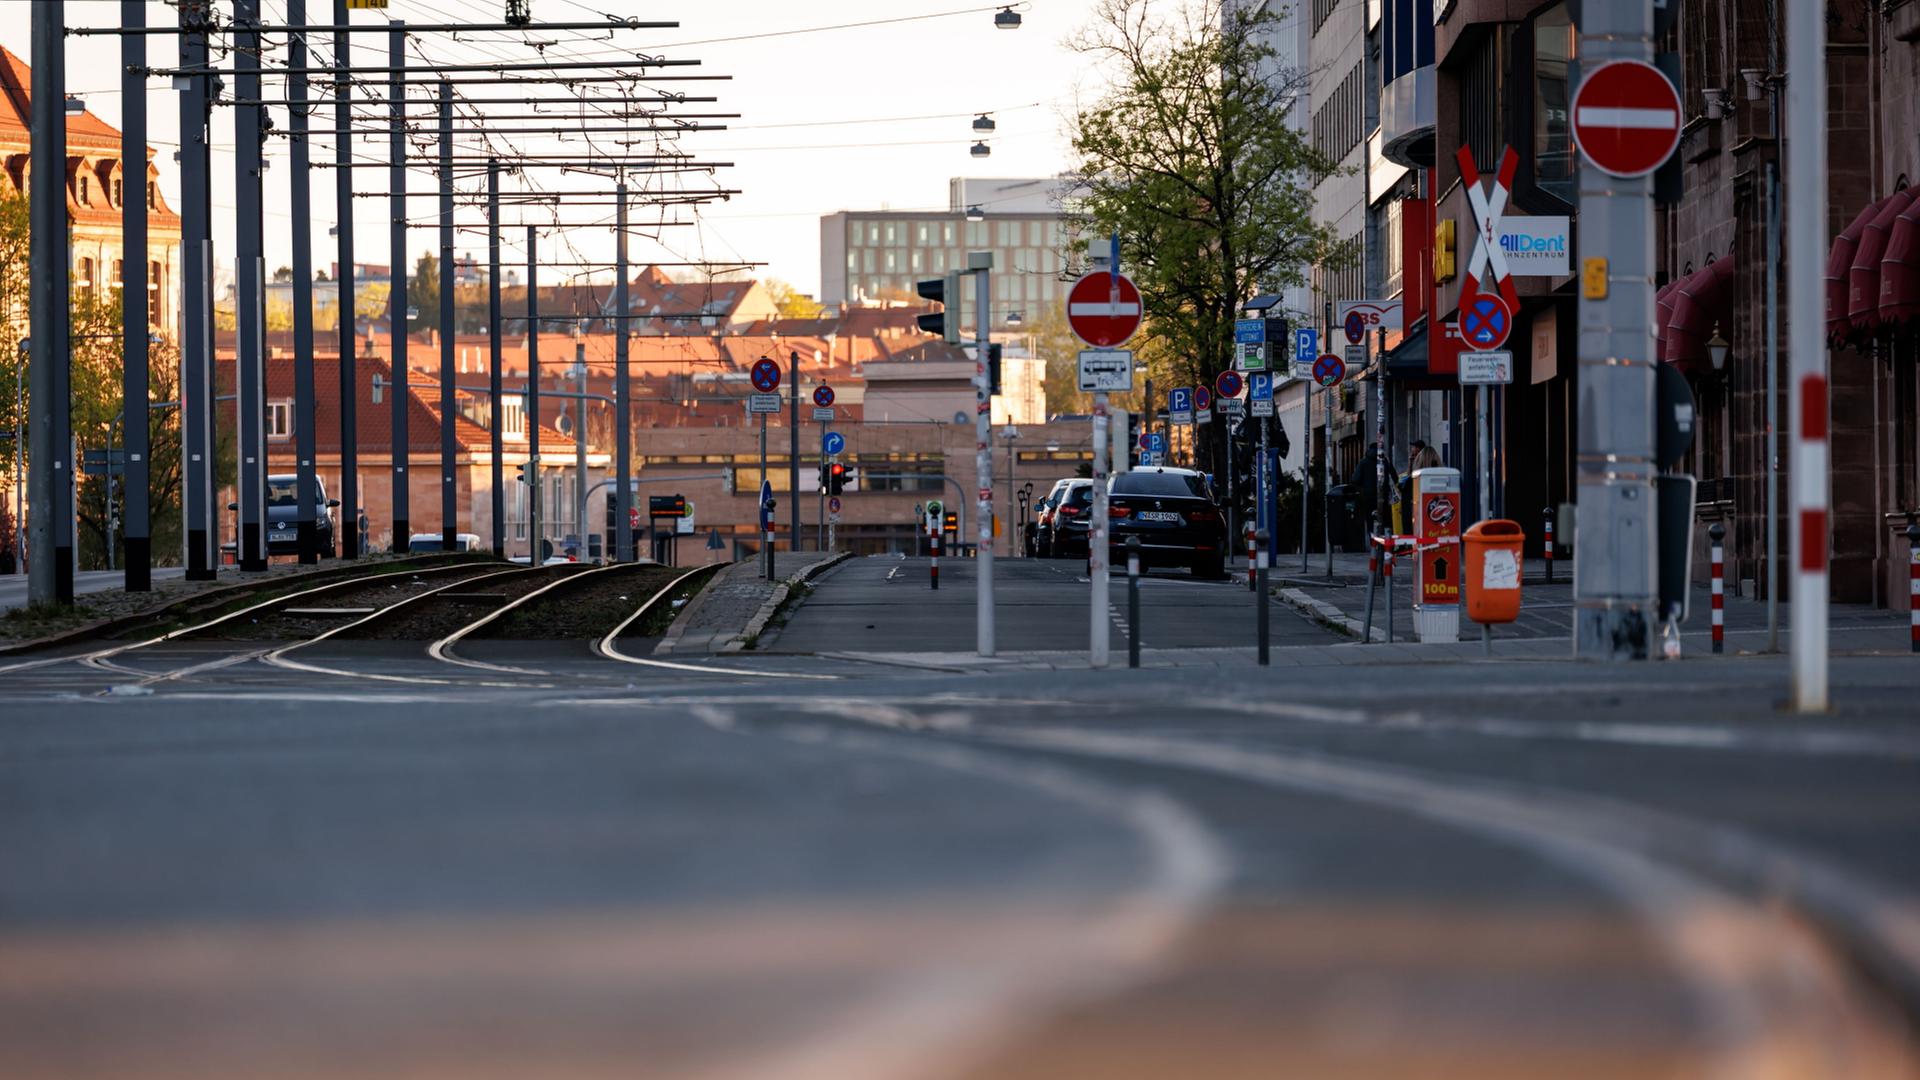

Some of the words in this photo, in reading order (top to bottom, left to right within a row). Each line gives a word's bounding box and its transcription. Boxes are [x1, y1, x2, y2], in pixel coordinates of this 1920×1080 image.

[1300, 333, 1311, 358] P
[1256, 375, 1268, 397] P
[1174, 391, 1185, 409] P
[1424, 583, 1446, 594] 100
